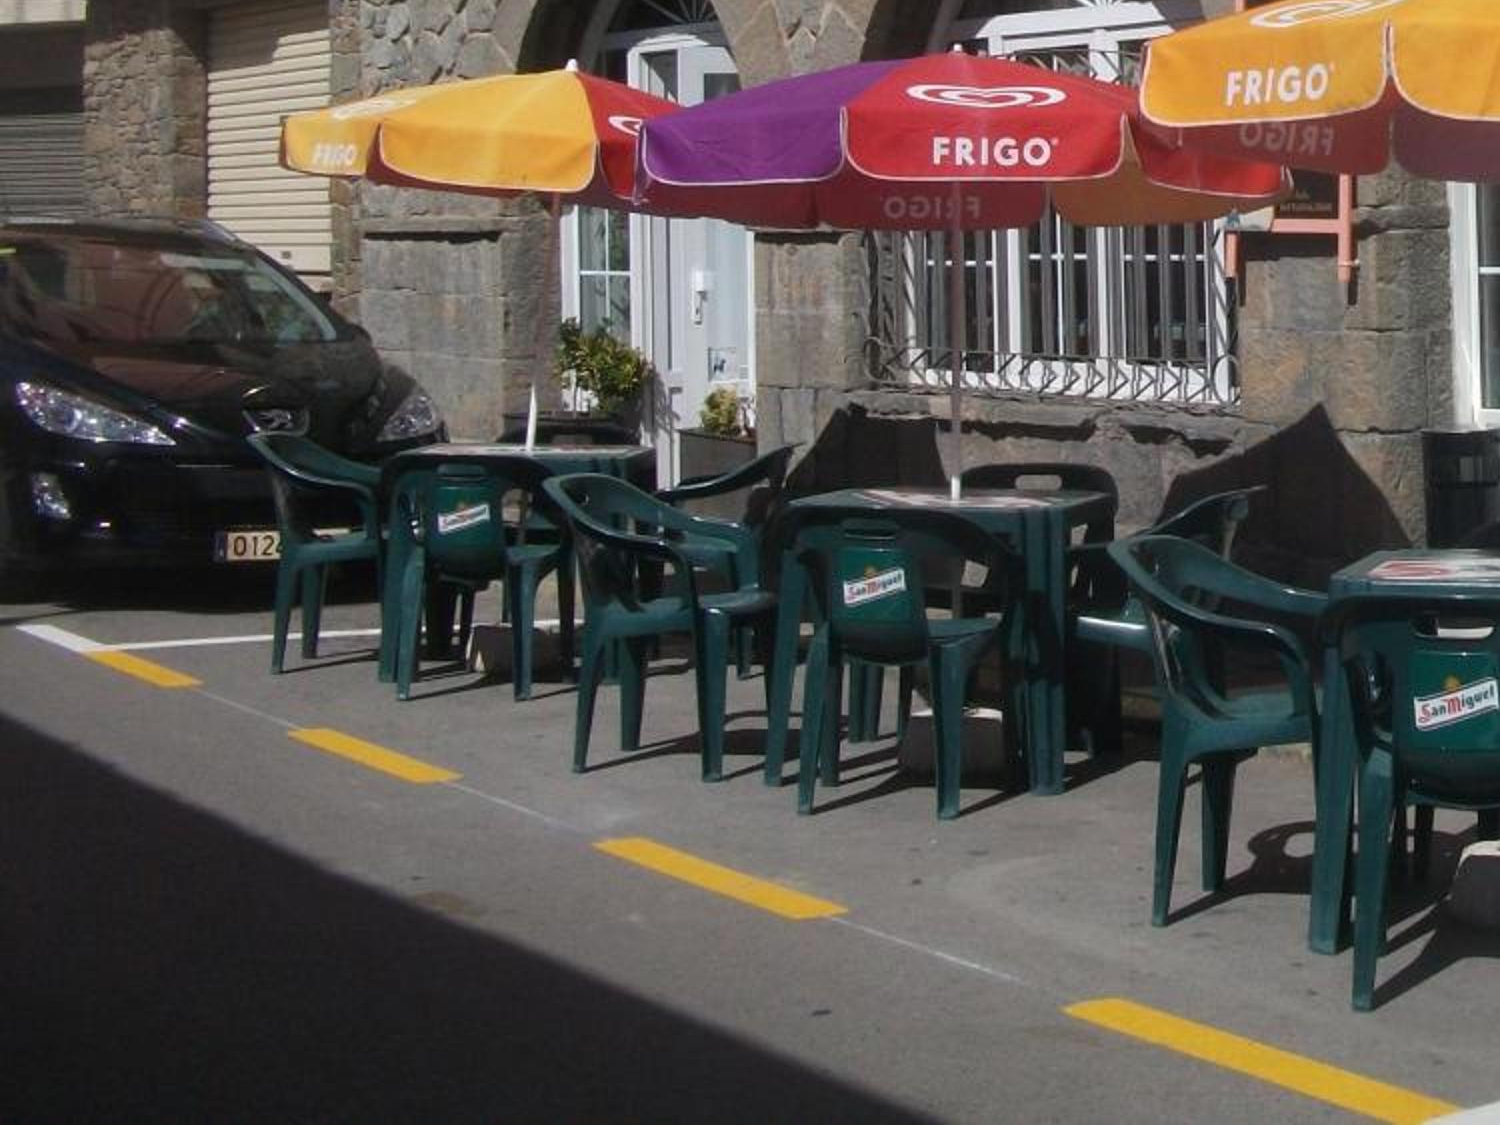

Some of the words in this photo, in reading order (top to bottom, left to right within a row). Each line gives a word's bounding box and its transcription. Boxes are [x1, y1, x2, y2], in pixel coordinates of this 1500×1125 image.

[1226, 63, 1329, 107] FRIGO
[933, 137, 1051, 166] FRIGO
[233, 535, 282, 556] 012
